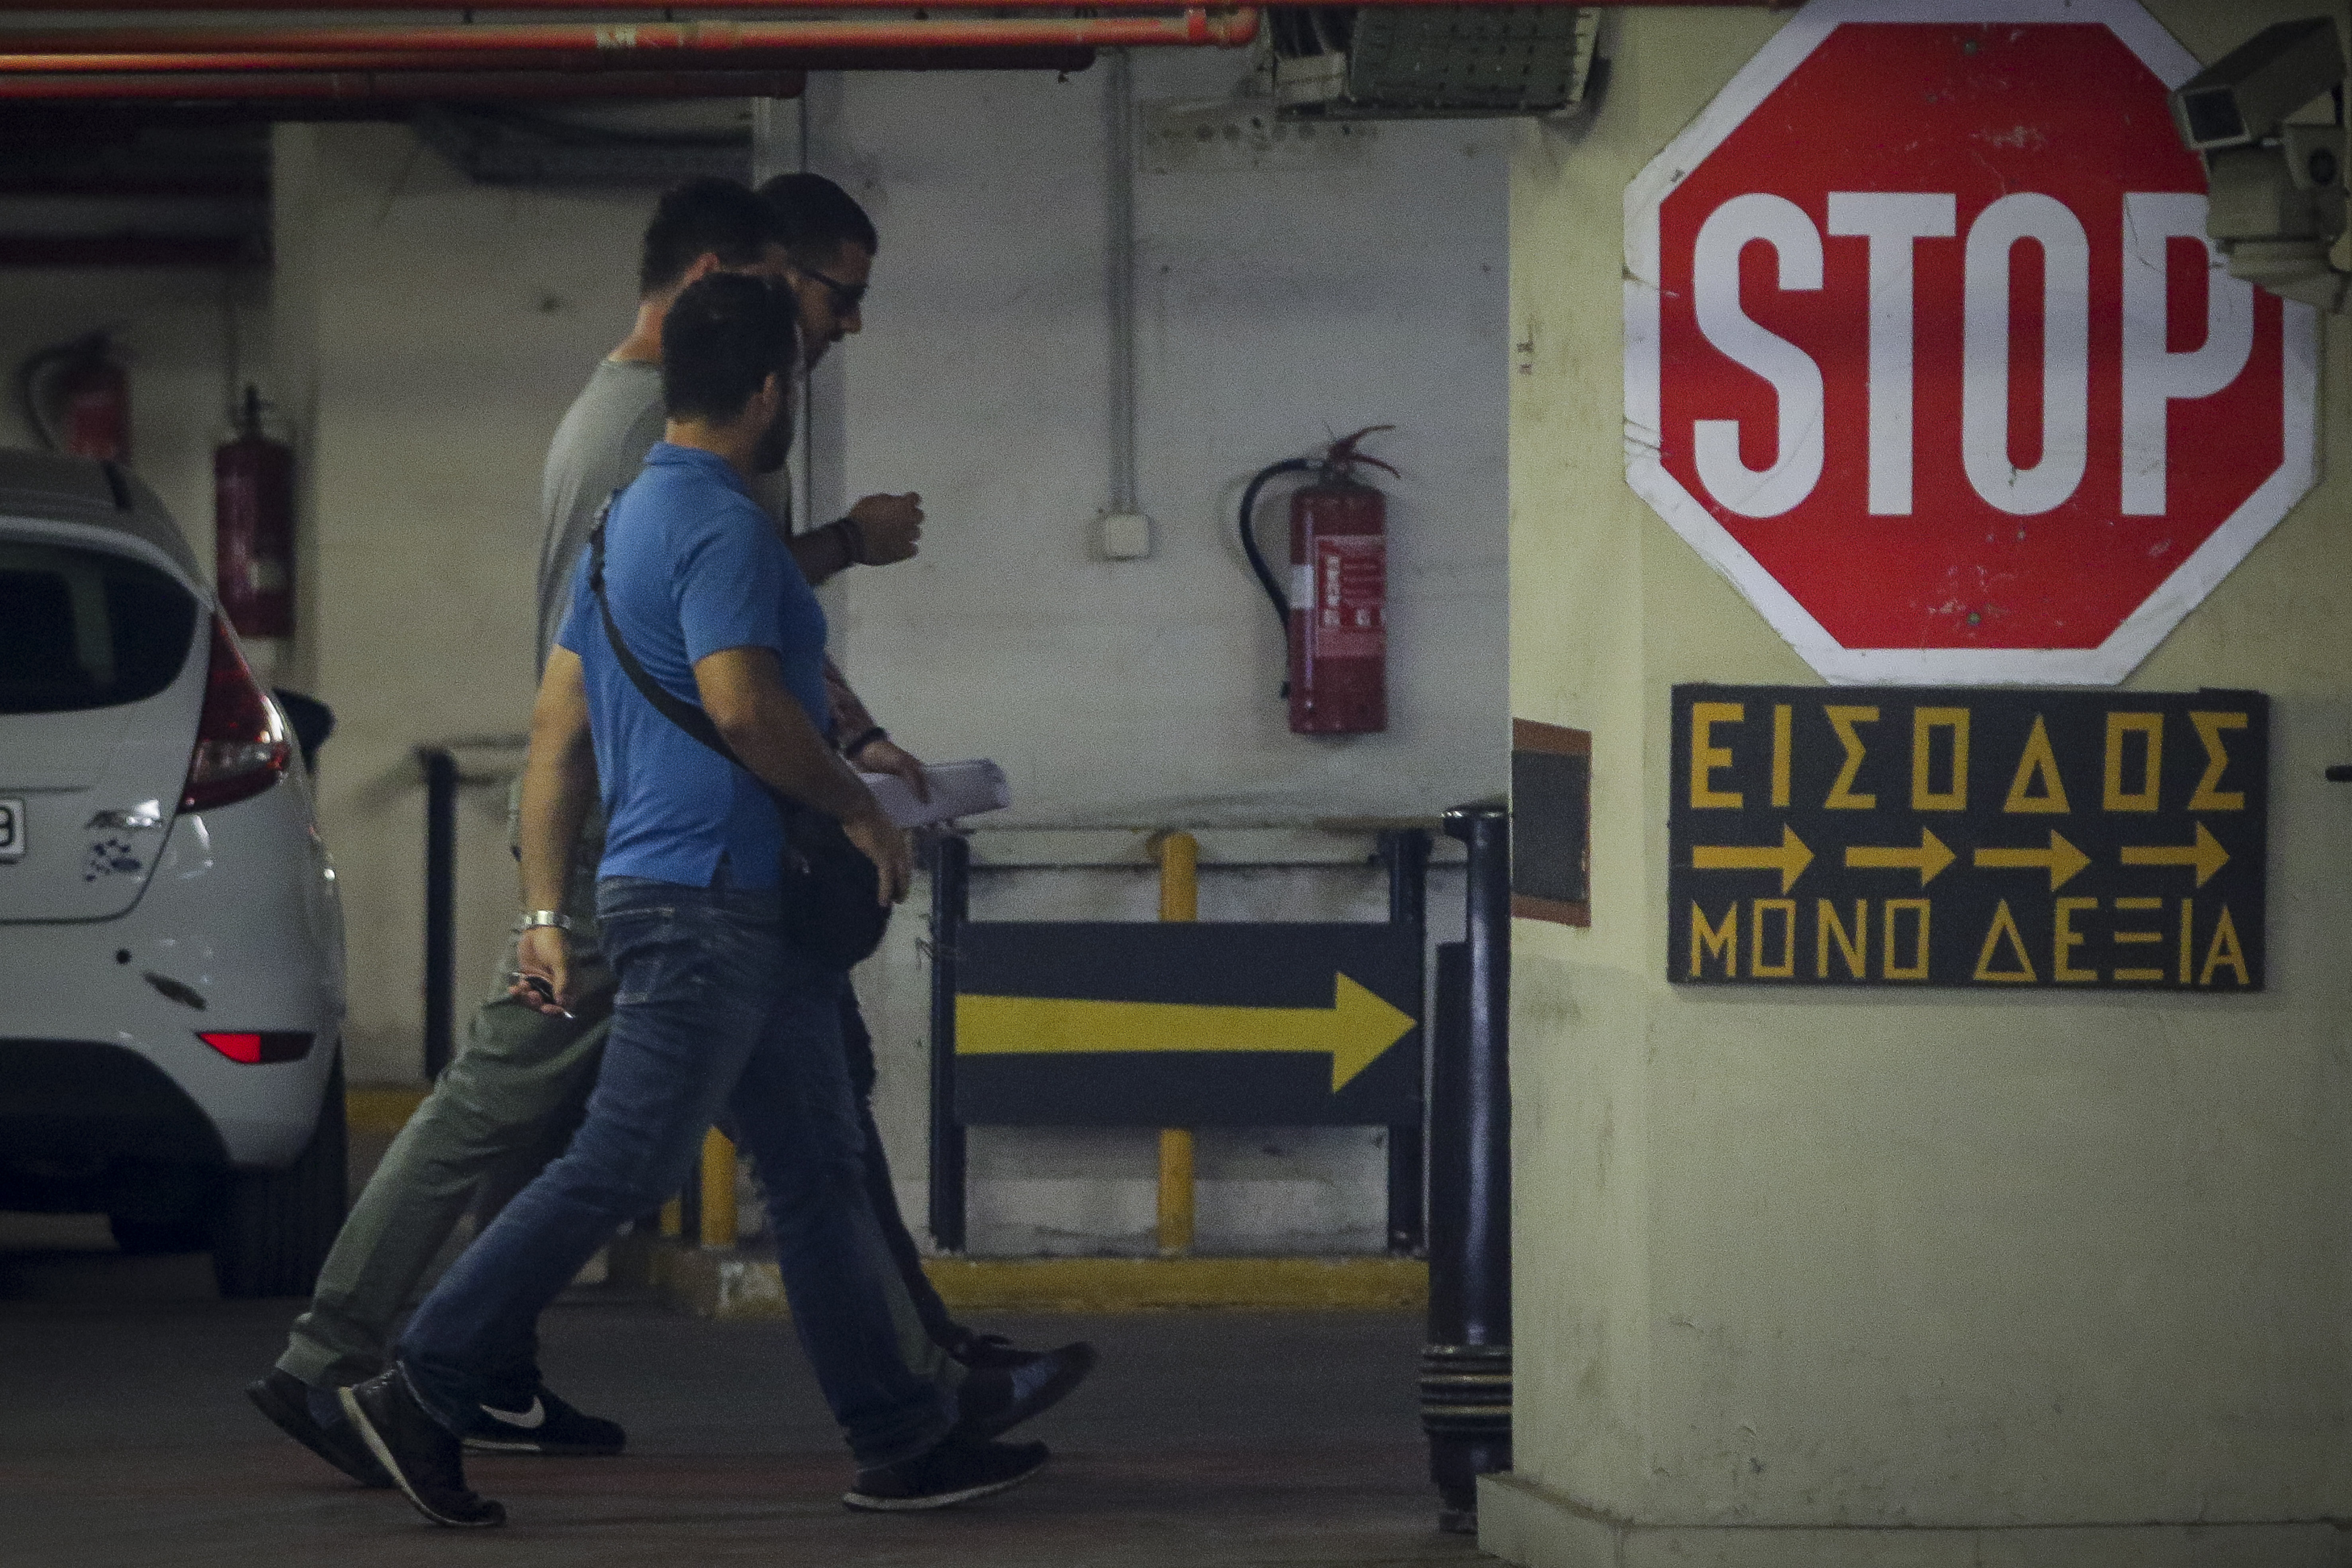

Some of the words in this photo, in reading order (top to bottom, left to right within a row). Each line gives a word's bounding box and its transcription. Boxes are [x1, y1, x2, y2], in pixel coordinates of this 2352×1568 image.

[1692, 192, 2254, 518] STOP
[1690, 701, 2248, 813] ΕΙΣΟΔΟΣ
[1690, 898, 1931, 980] ΜΟΝΟ
[1973, 897, 2250, 985] ΔΕΞΙΑ
